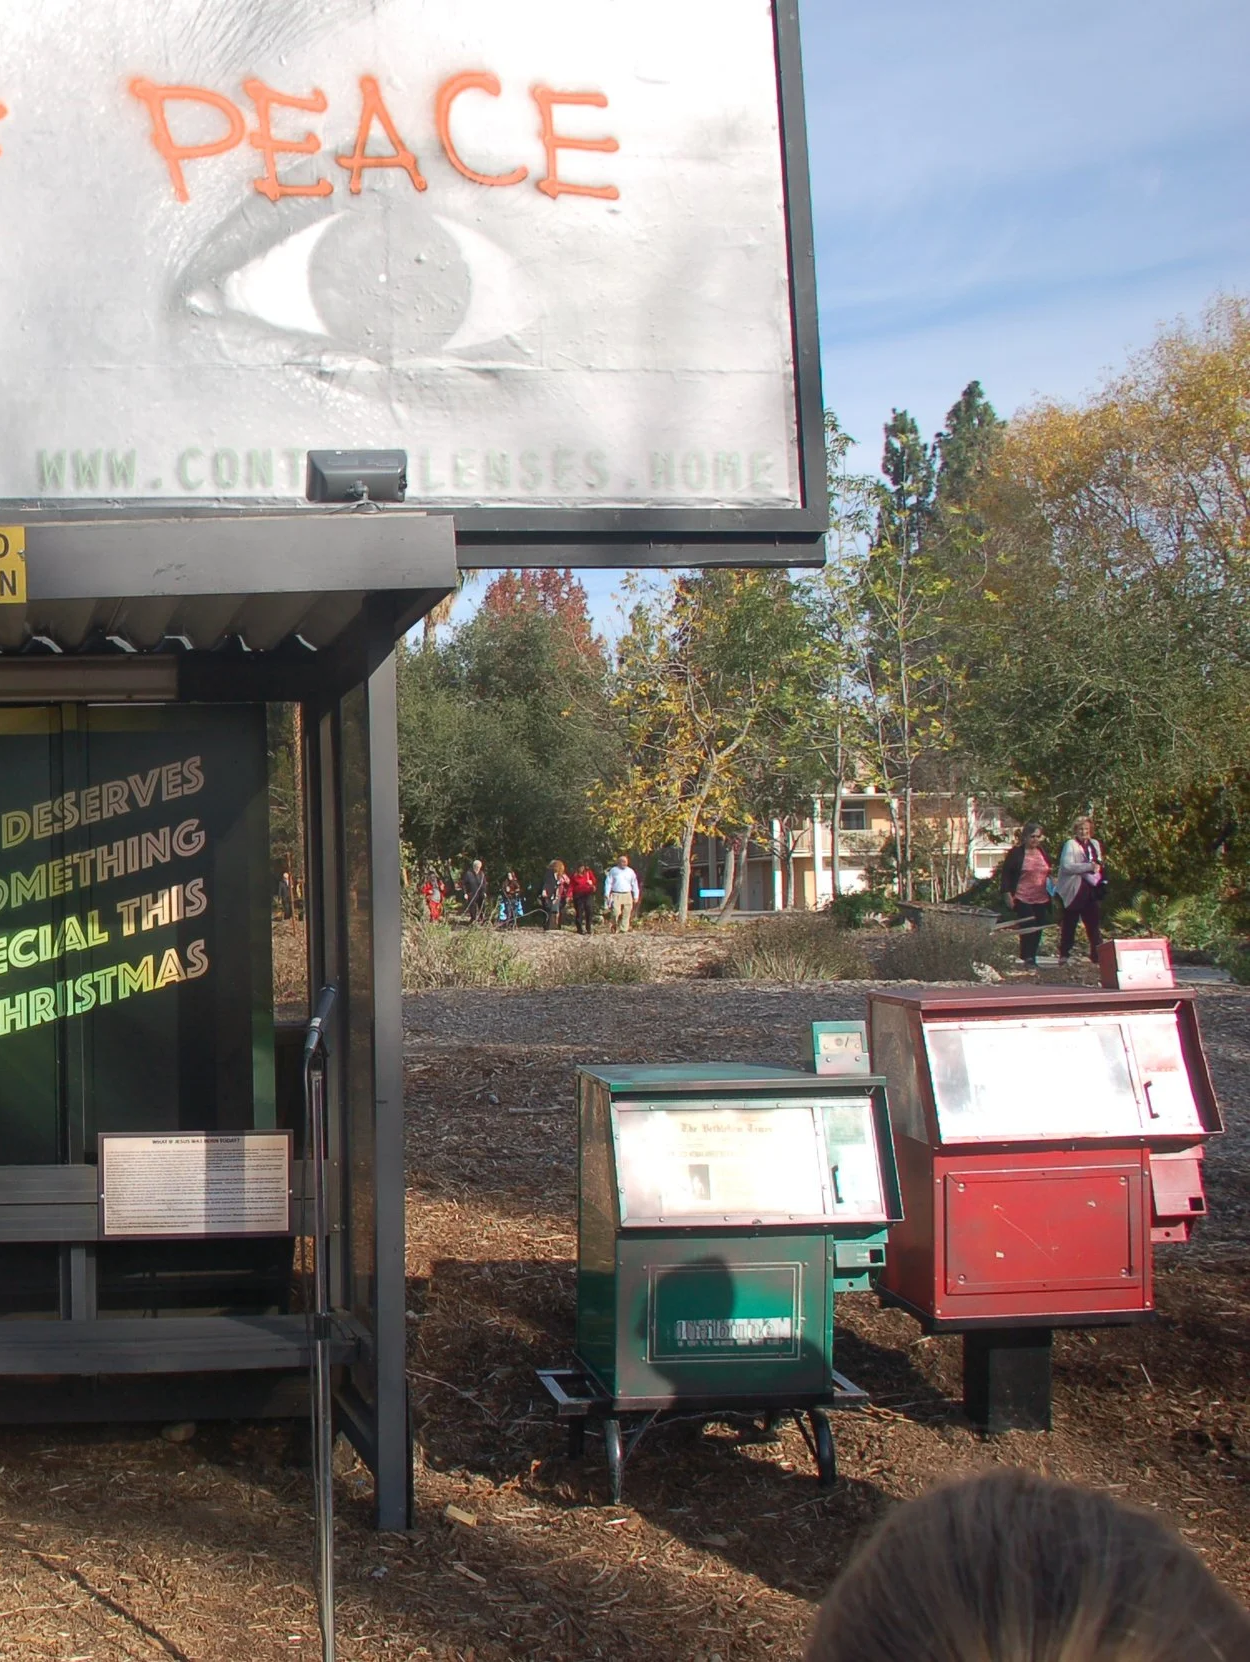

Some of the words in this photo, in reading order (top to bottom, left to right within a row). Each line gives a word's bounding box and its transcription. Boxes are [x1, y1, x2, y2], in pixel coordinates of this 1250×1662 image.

[128, 70, 620, 203] PEACE
[38, 447, 775, 493] WWW.CONTLENSES.HOME
[1, 755, 205, 849] DESERVES
[117, 878, 208, 937] THIS
